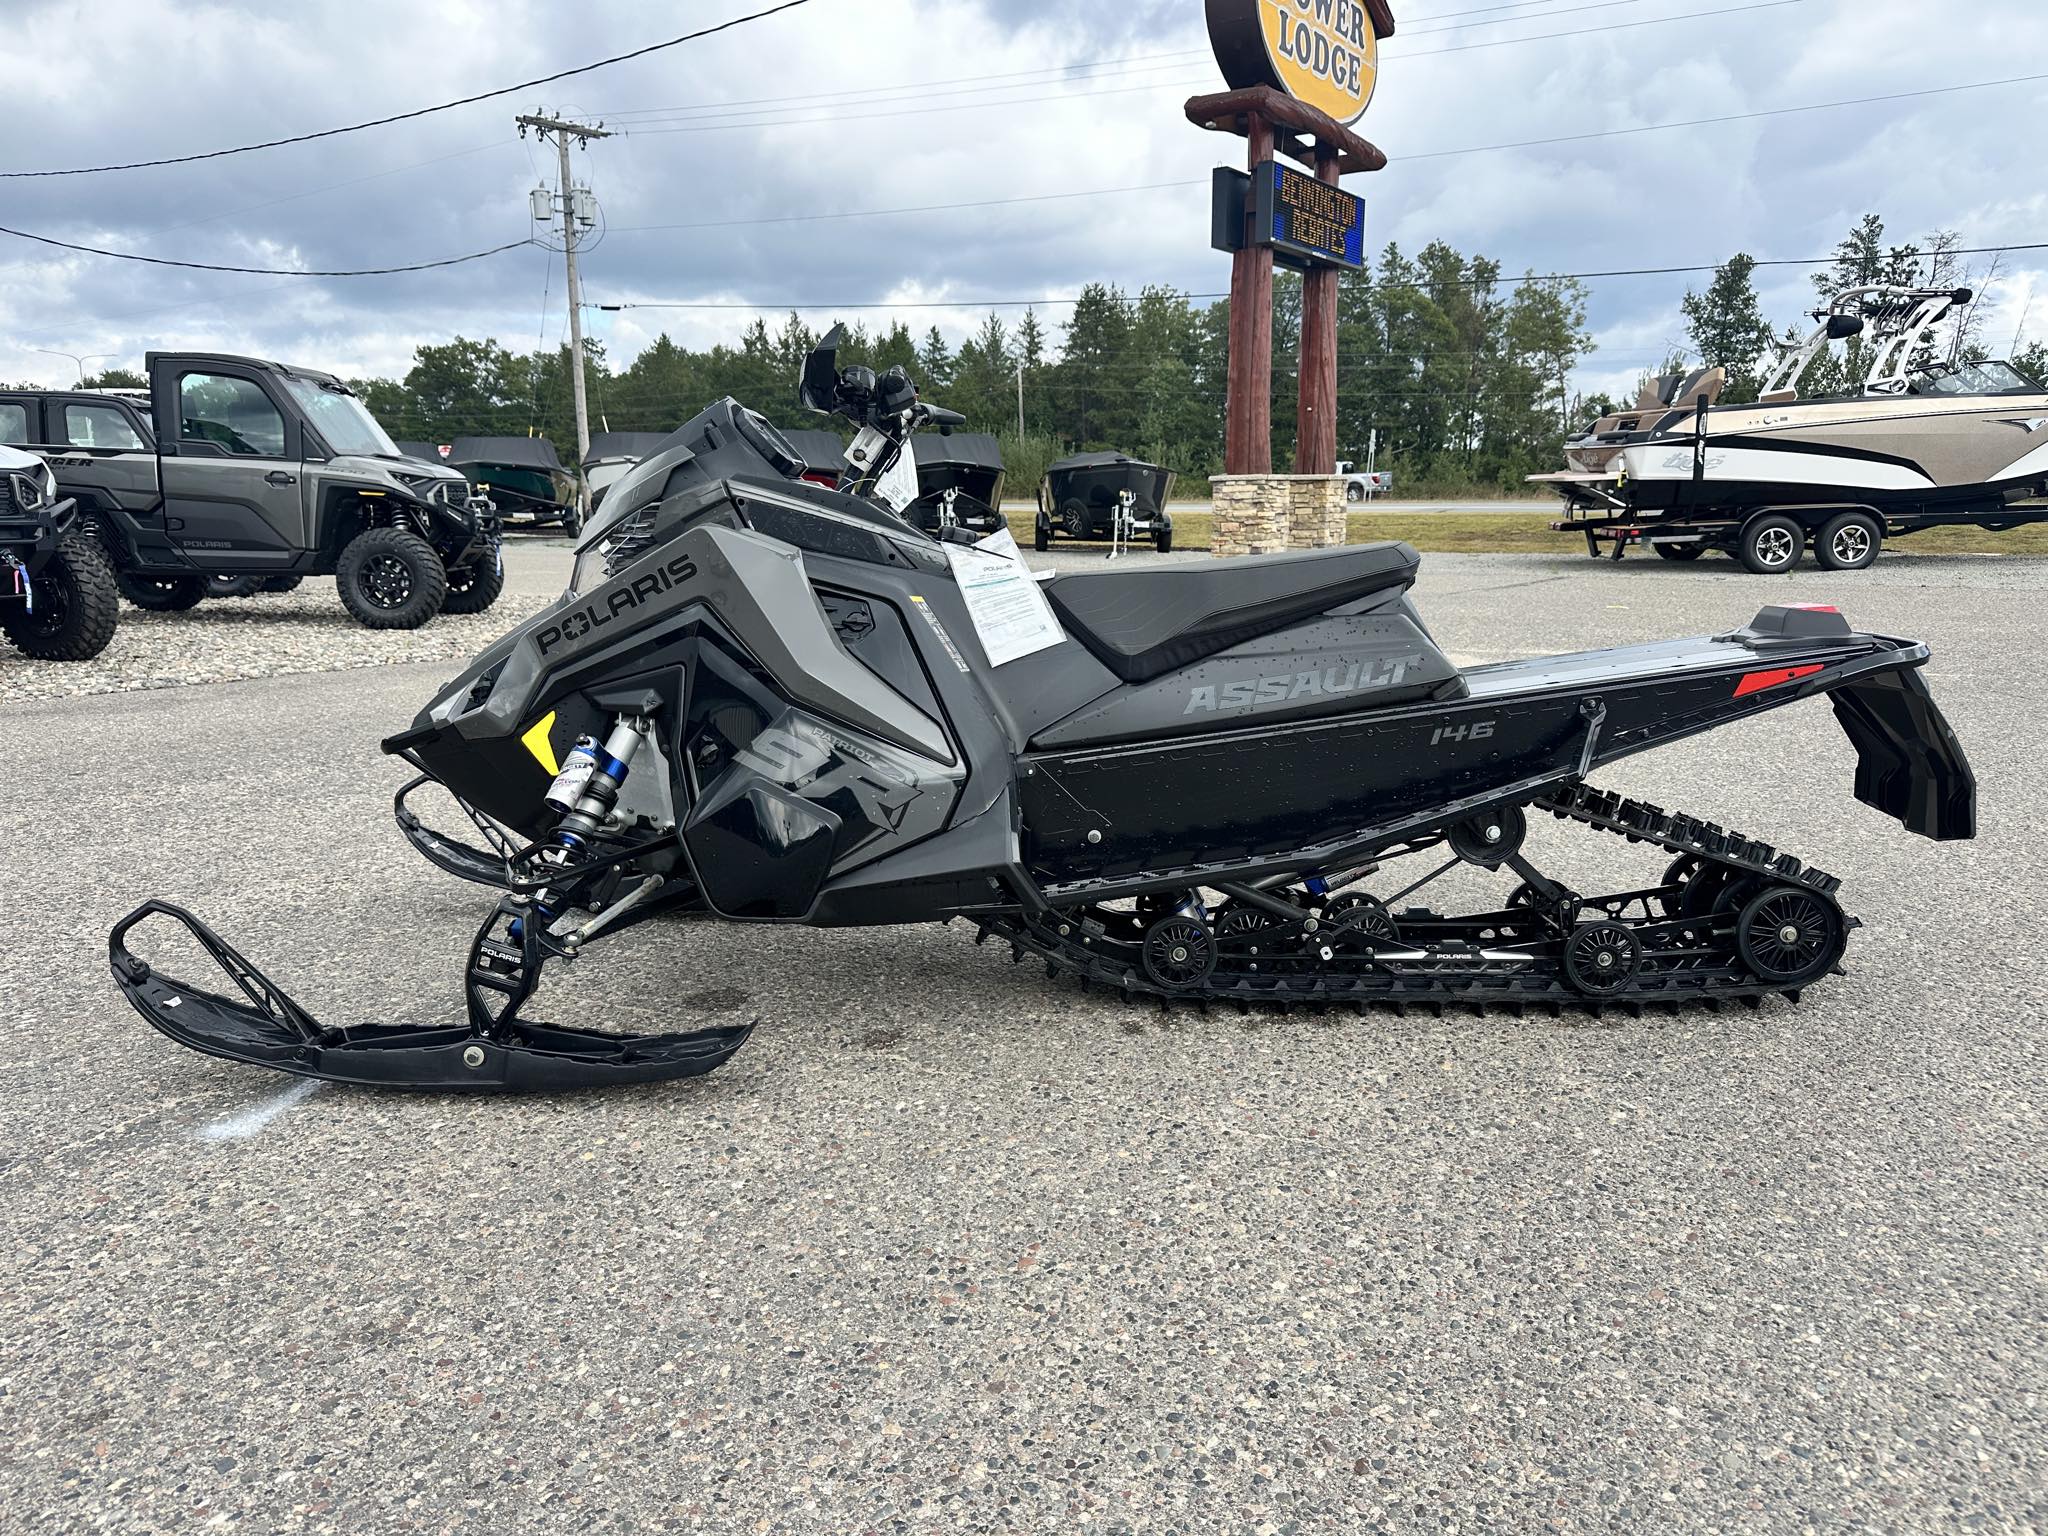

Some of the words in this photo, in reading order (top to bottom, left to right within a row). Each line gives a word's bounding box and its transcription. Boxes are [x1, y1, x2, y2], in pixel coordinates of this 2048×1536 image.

[1296, 0, 1364, 49] WER
[1279, 9, 1361, 96] LODGE
[1292, 208, 1346, 255] REBATES
[183, 540, 232, 549] POLARIS
[535, 553, 698, 656] POLARIS
[1183, 653, 1423, 716] ASSAULT
[811, 726, 876, 761] PATRIOT
[1430, 720, 1497, 746] 146
[480, 946, 522, 964] POLARIS
